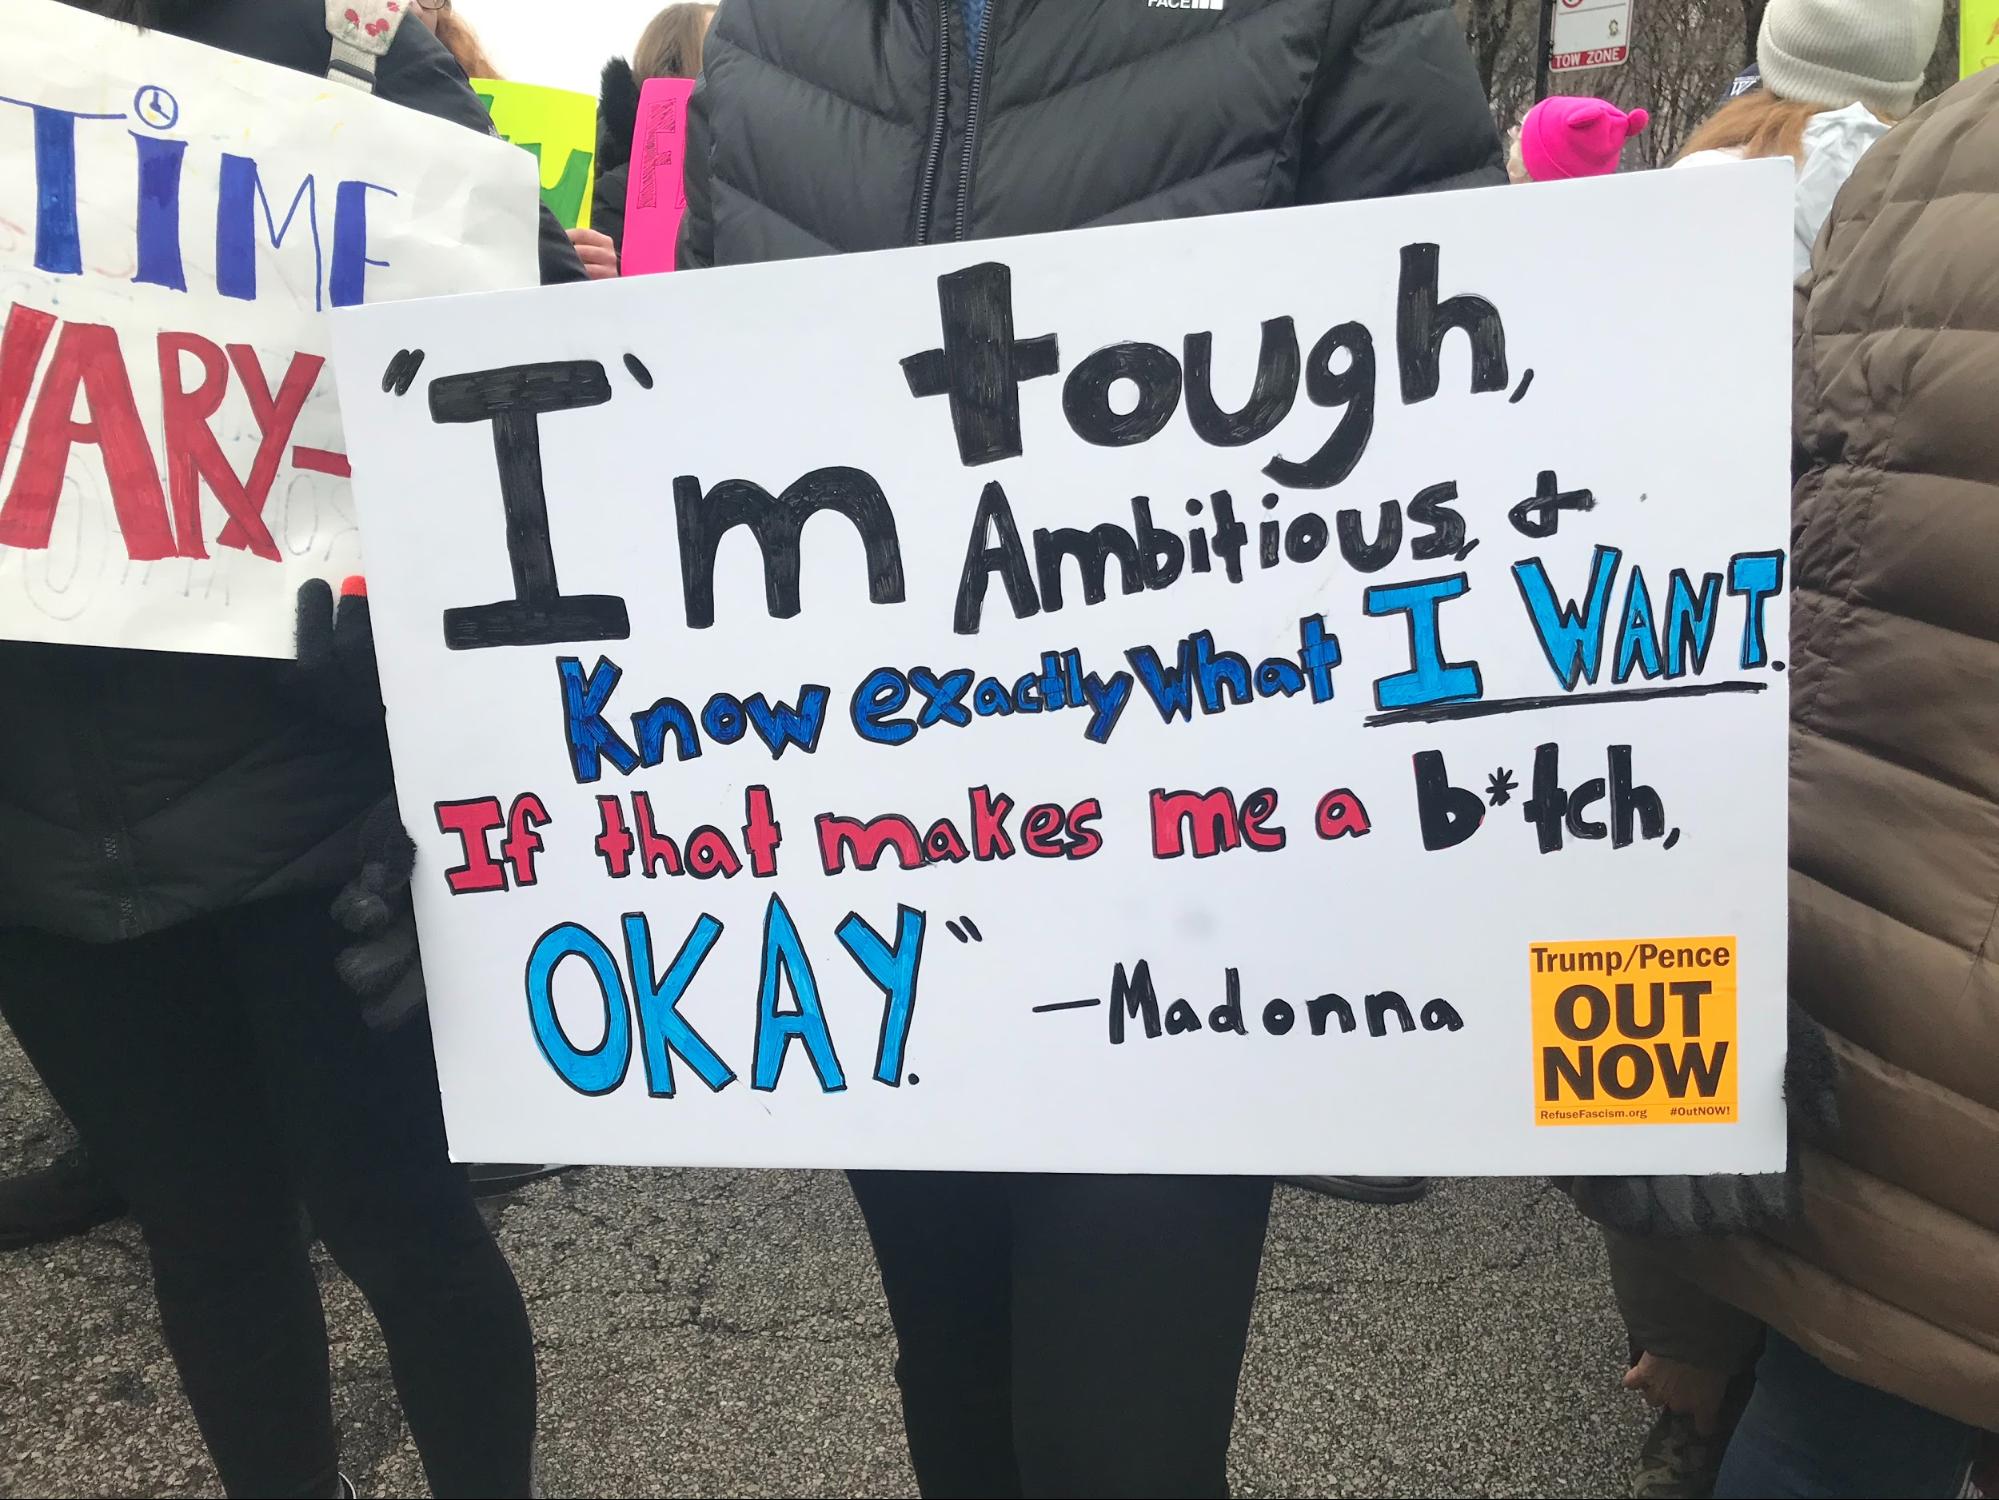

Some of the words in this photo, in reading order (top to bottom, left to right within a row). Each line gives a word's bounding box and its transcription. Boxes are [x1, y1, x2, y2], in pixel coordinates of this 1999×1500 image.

[1555, 54, 1581, 68] TOW
[1586, 48, 1620, 64] ZONE
[899, 242, 1536, 490] tough,
[953, 479, 1480, 634] Ambitious,
[556, 655, 830, 784] Know
[849, 647, 1133, 745] exactly
[1363, 572, 1484, 711] I
[1510, 544, 1787, 692] WANT.
[434, 792, 552, 894] If
[595, 784, 781, 879] that
[815, 784, 1103, 876] makes
[1149, 787, 1286, 859] me
[1315, 787, 1371, 840] a
[1531, 943, 1730, 976] Trump/Pence
[1554, 980, 1712, 1041] OUT
[1542, 1041, 1729, 1102] NOW
[1540, 1109, 1648, 1120] RefuseFascism.org
[1670, 1106, 1730, 1117] #OutNOW!
